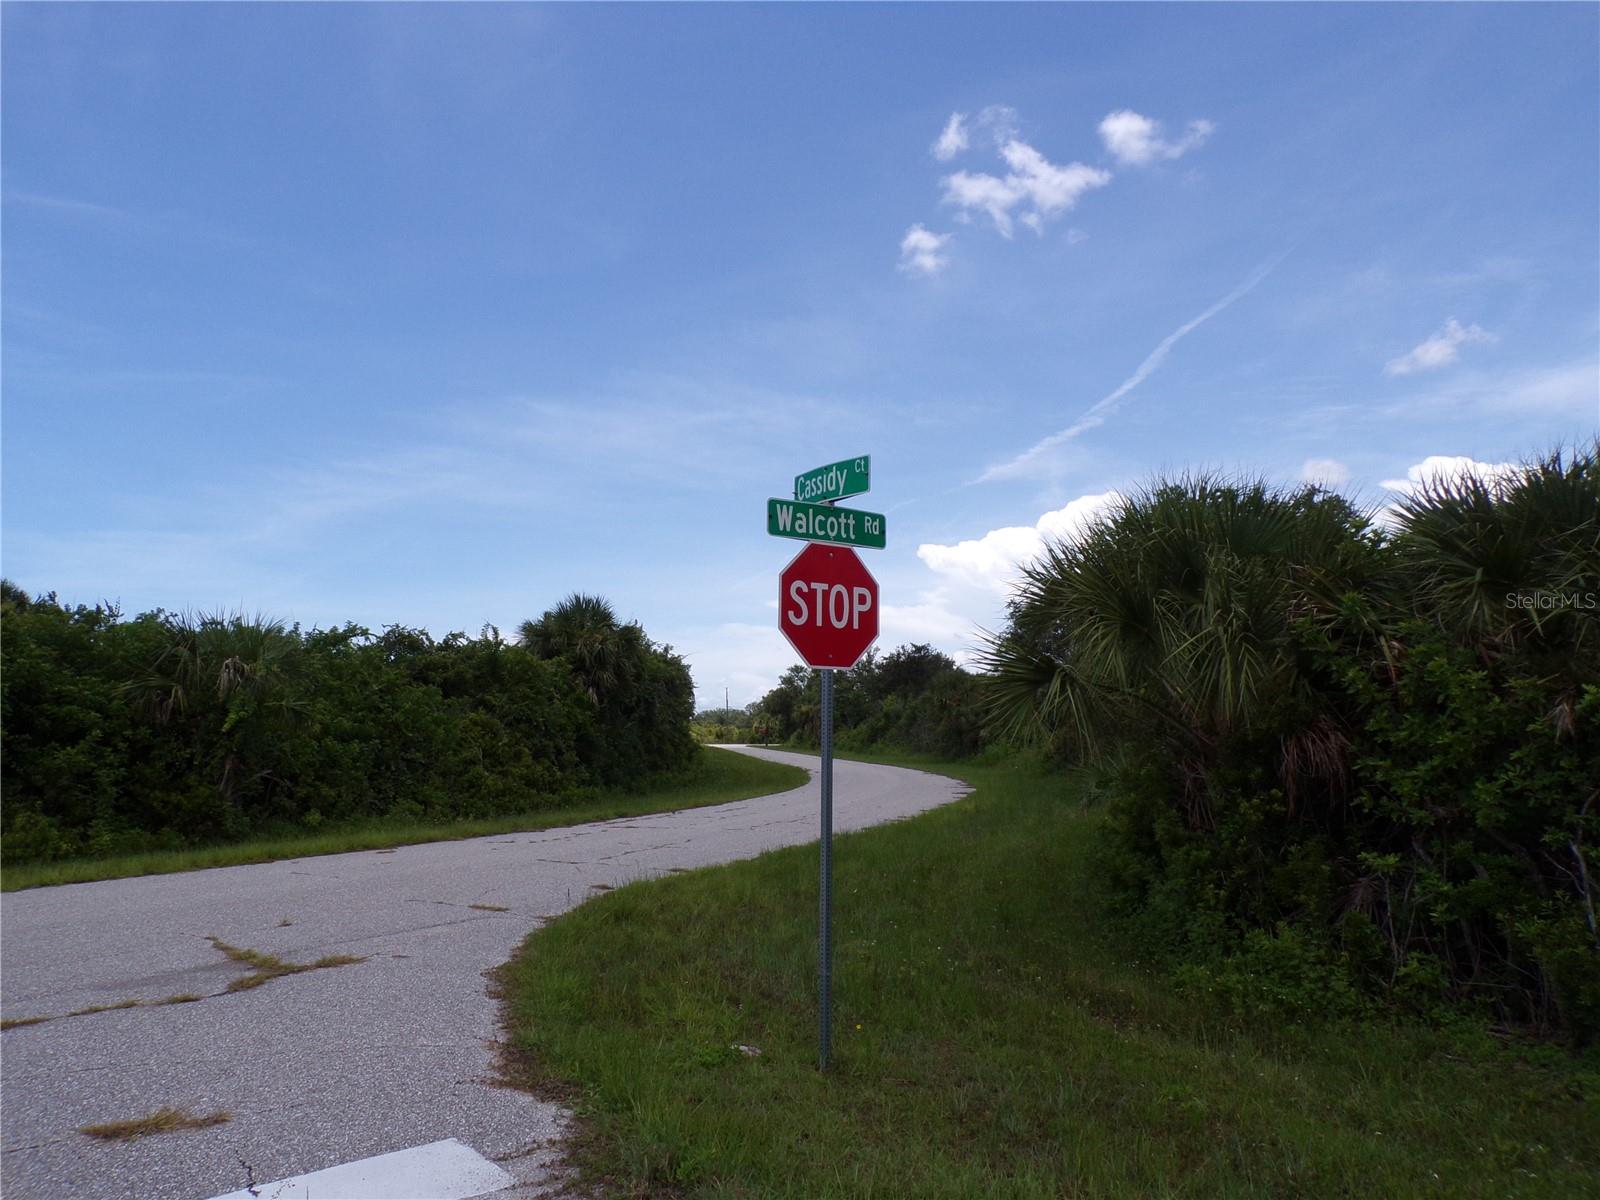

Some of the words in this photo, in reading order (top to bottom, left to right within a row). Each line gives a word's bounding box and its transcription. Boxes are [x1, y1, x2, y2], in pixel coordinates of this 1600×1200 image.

[797, 466, 848, 501] Cassidy
[854, 459, 865, 473] Ct
[776, 503, 856, 540] Walcott
[864, 516, 880, 535] Rd
[788, 579, 872, 630] STOP
